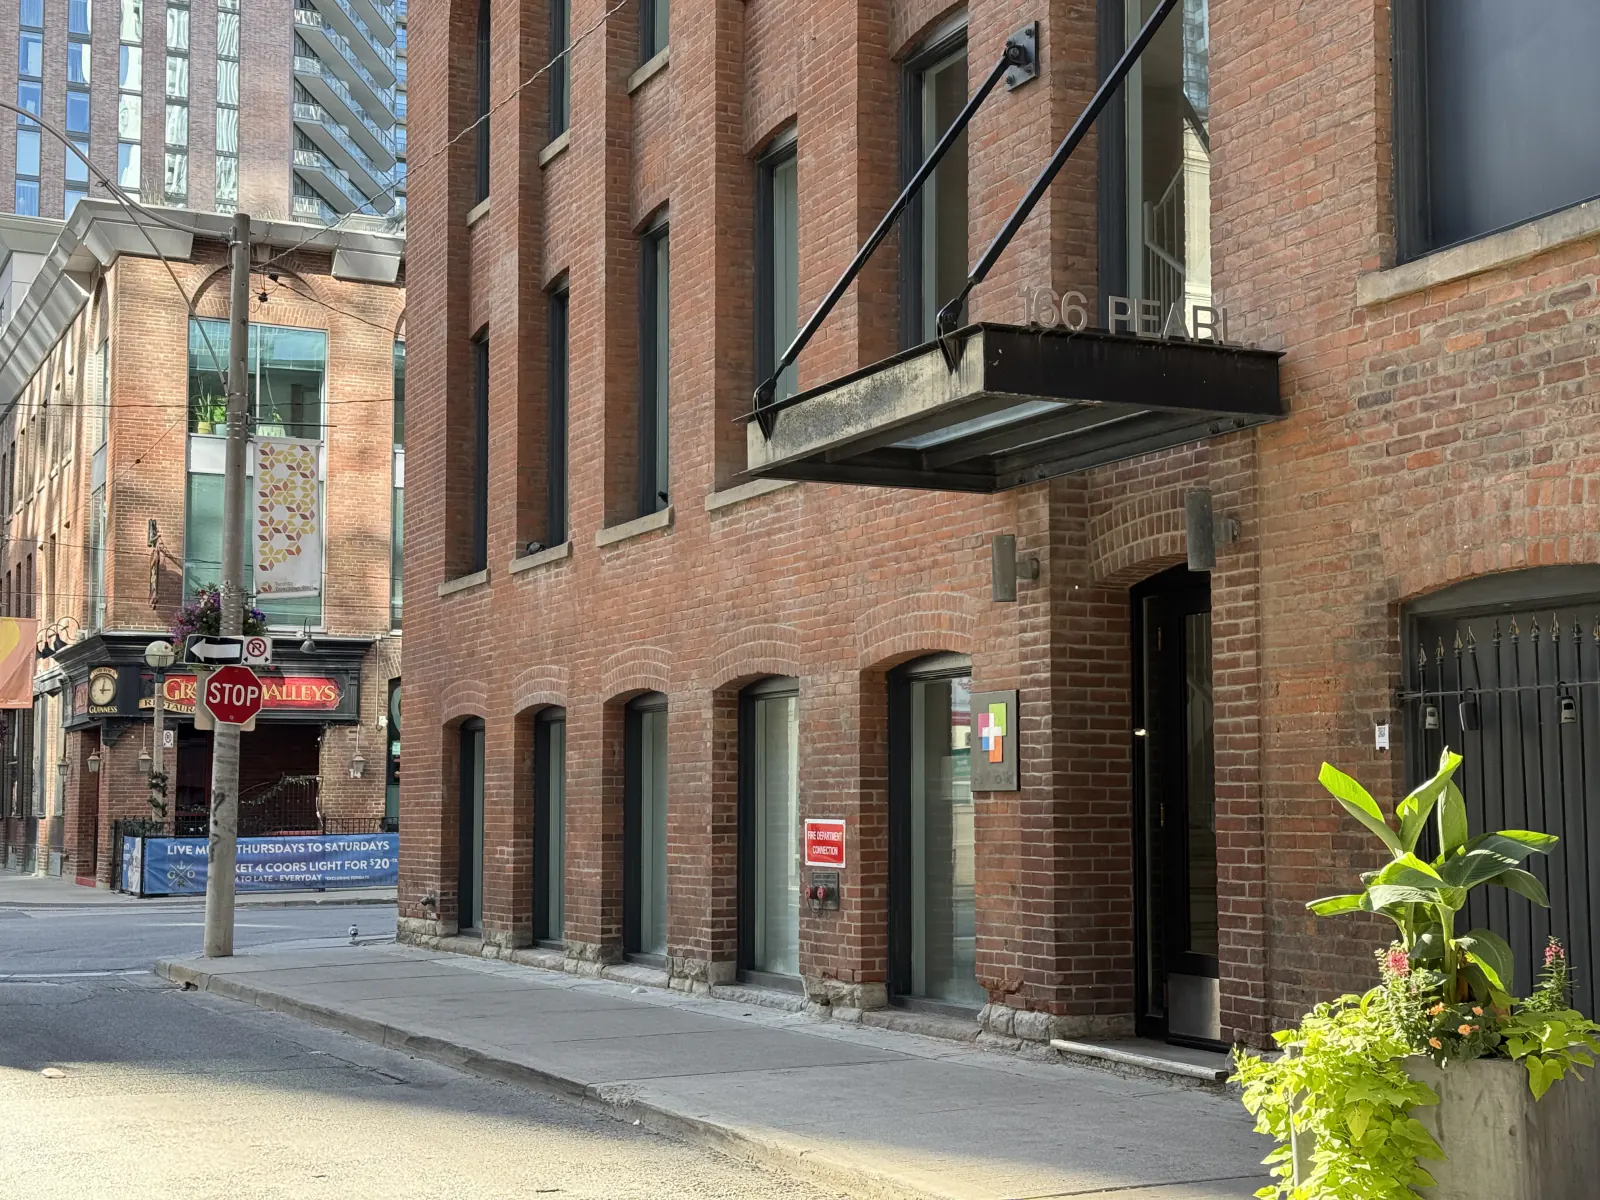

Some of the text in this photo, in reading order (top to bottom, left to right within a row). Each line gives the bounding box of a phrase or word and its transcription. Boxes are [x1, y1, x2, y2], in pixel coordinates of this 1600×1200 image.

[1017, 286, 1243, 347] 166 PEARL
[209, 682, 259, 706] STOP
[89, 705, 118, 714] GUINNESS
[808, 831, 843, 841] FIRE DEPARTMENT
[167, 846, 192, 855] LIVE
[236, 843, 305, 853] THURSDAYS
[307, 843, 323, 852] TO
[325, 841, 390, 852] SATURDAYS
[812, 845, 839, 856] CONNECTION
[255, 863, 264, 872] 4
[265, 862, 306, 872] COORS
[309, 860, 342, 871] LIGHT
[344, 860, 367, 870] FOR
[241, 875, 252, 883] TO
[253, 874, 273, 882] LATE
[280, 874, 322, 882] EVERYDAY
